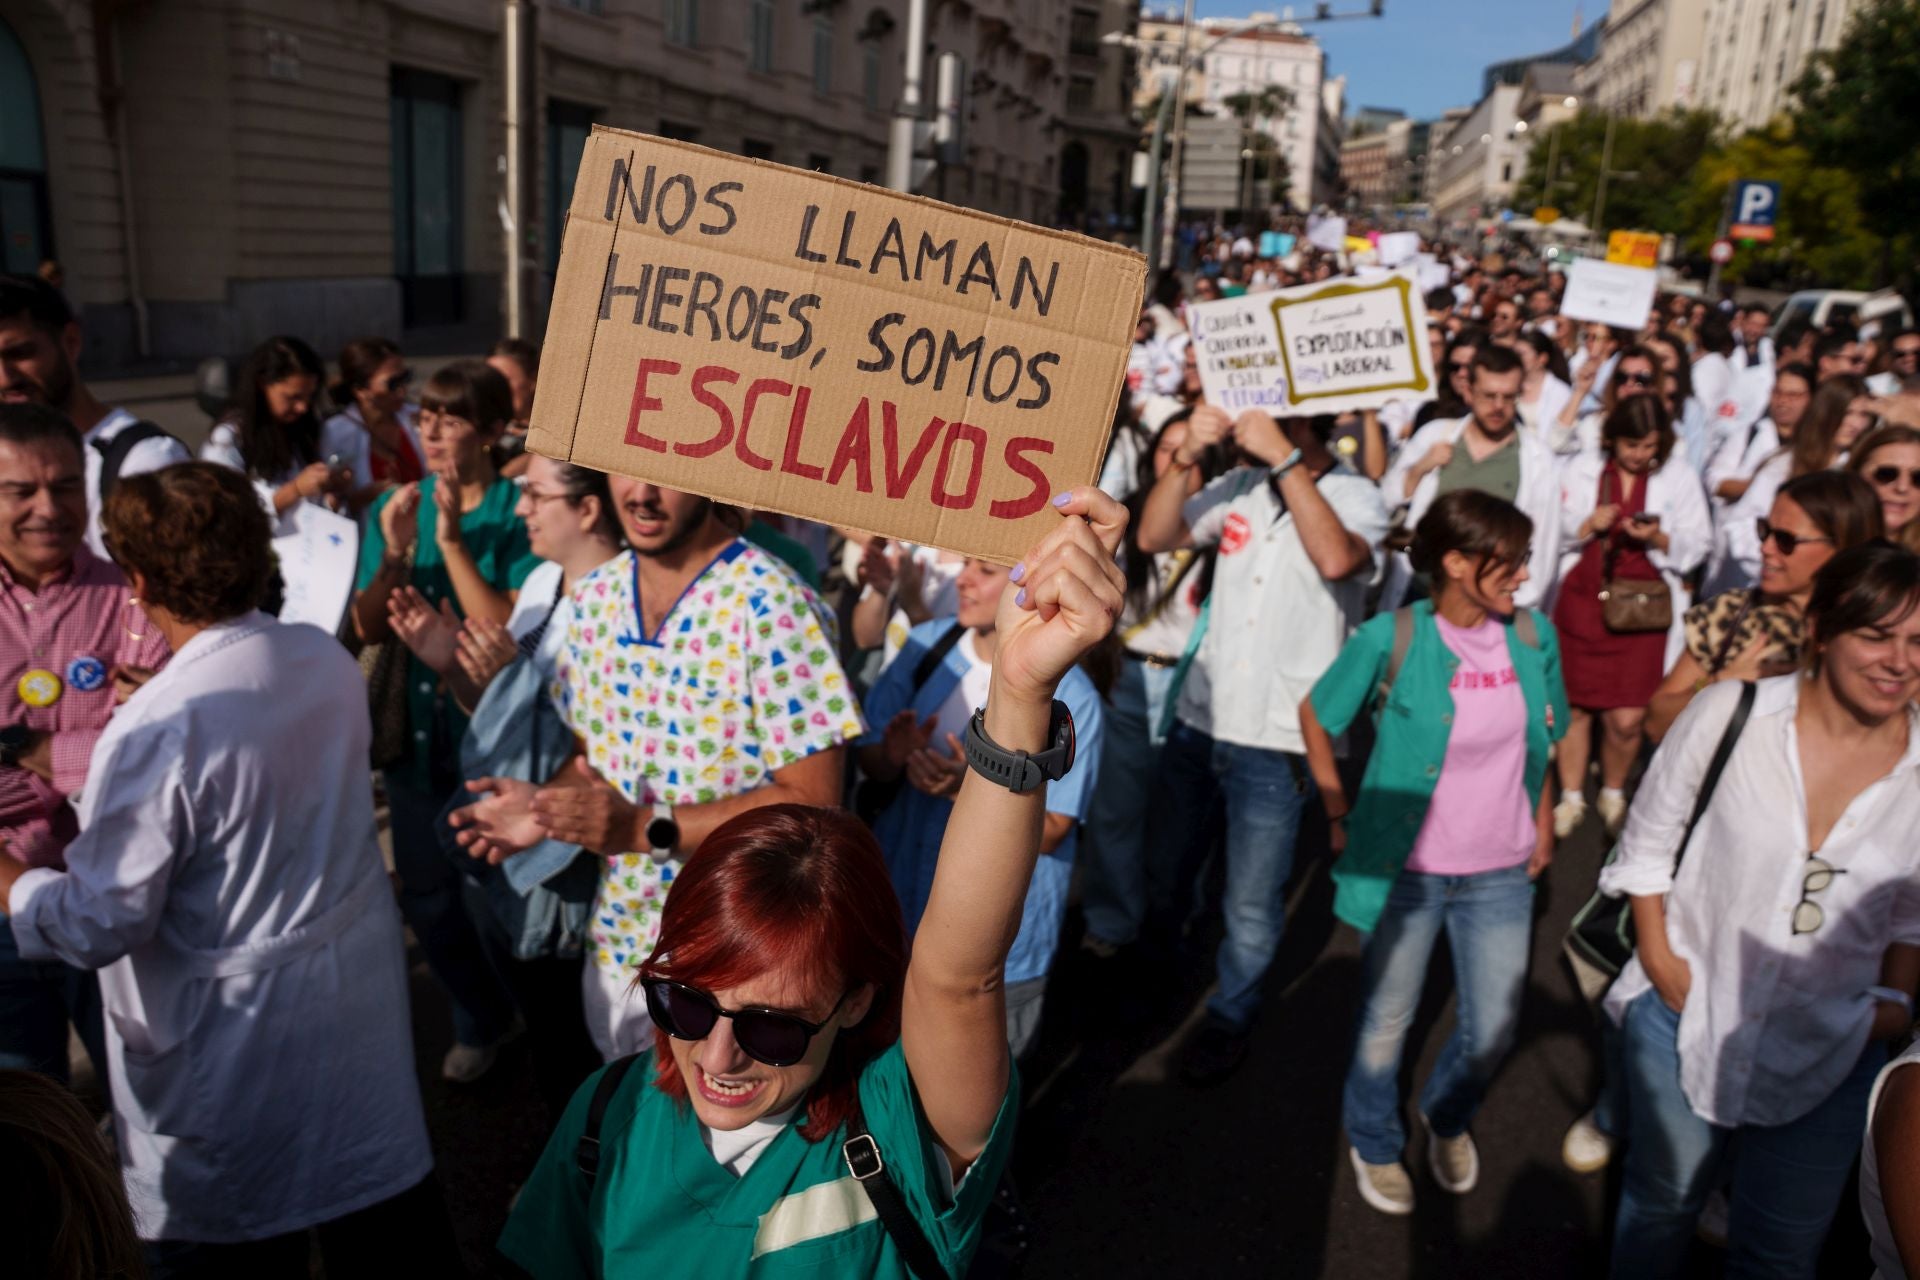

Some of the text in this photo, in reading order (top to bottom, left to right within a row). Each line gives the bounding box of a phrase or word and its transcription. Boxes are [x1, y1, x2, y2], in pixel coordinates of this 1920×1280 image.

[603, 157, 1061, 317] NOS LLAMAN
[1738, 183, 1774, 223] P
[600, 252, 1061, 410] HEROES, SOMOS
[1294, 318, 1406, 358] EXPLOTACIÓN
[1322, 355, 1396, 380] LABORAL
[623, 358, 1055, 520] ESCLAVOS
